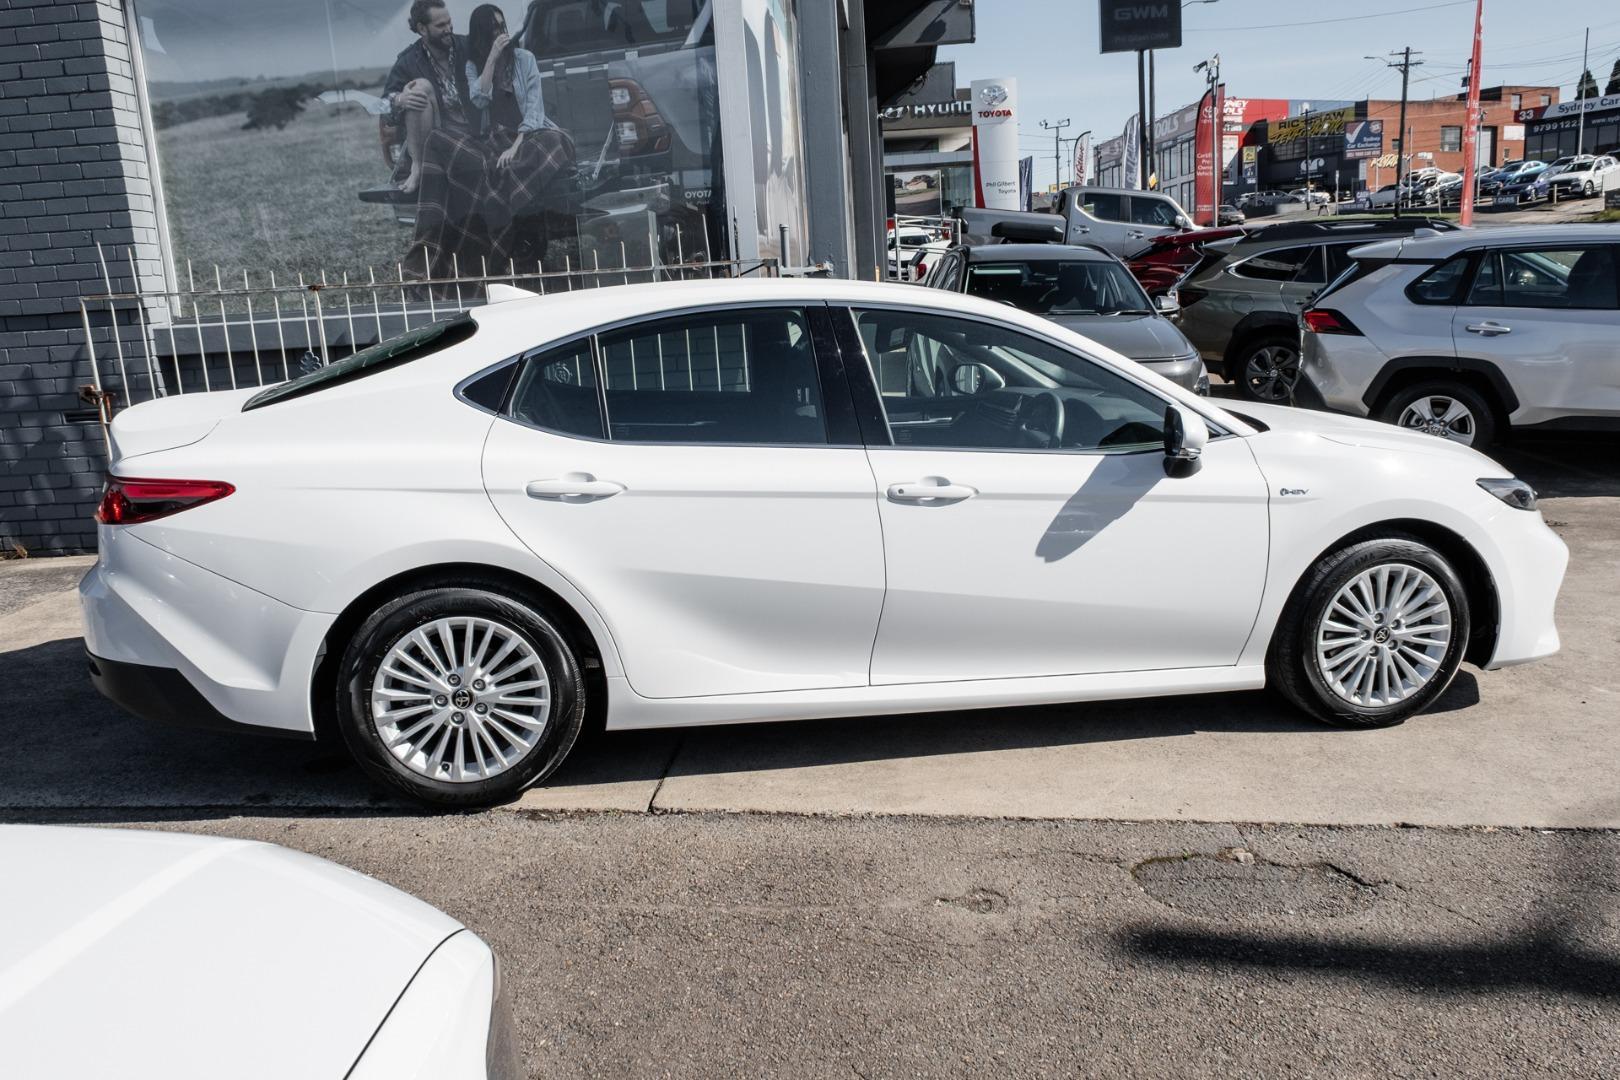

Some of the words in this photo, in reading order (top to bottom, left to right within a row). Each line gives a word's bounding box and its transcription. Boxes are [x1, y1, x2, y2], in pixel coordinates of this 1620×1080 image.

[1114, 5, 1169, 21] GWM
[1558, 98, 1597, 114] Sydney
[978, 108, 1013, 118] TOYOTA
[1519, 109, 1534, 121] 33
[1533, 122, 1558, 133] 9799
